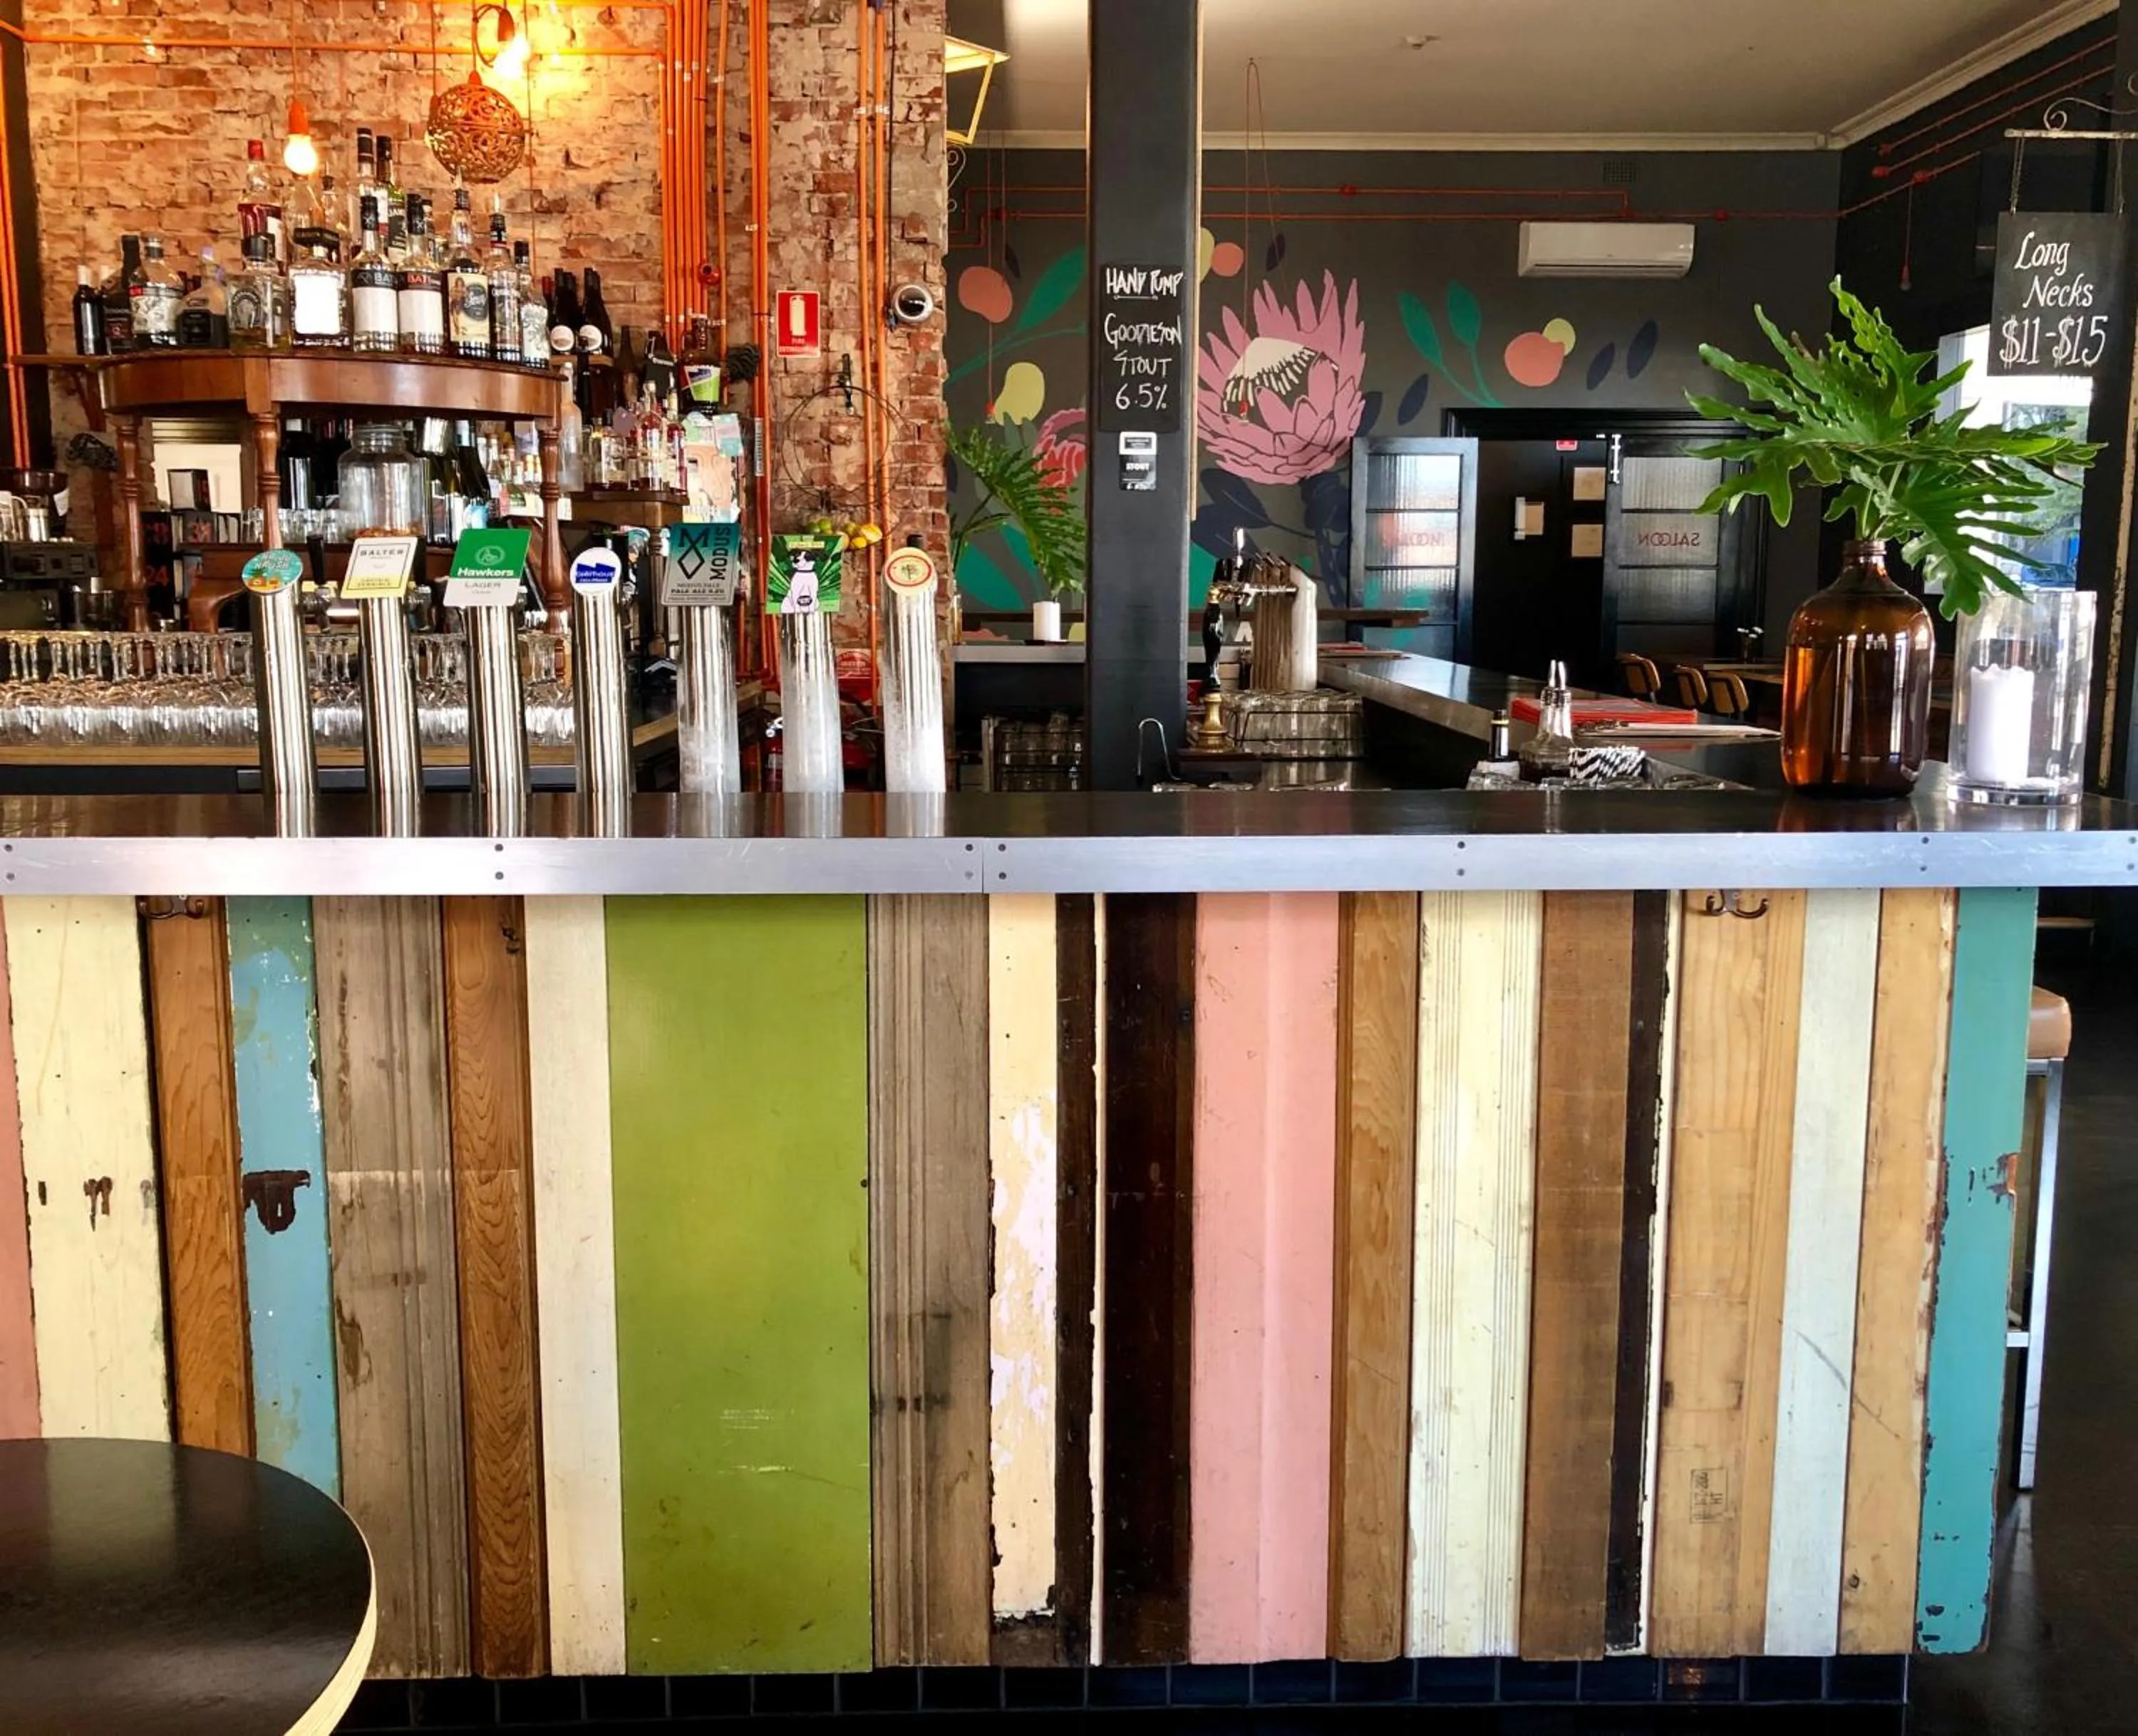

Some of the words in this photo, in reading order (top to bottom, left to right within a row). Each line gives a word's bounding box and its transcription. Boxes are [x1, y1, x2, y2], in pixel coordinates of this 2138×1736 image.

[2014, 232, 2070, 276] Long
[2023, 273, 2094, 308] Necks
[1112, 350, 1172, 377] STOUT
[1115, 383, 1168, 410] 6.5%
[710, 527, 730, 581] MODUS
[457, 567, 514, 577] Hawkers
